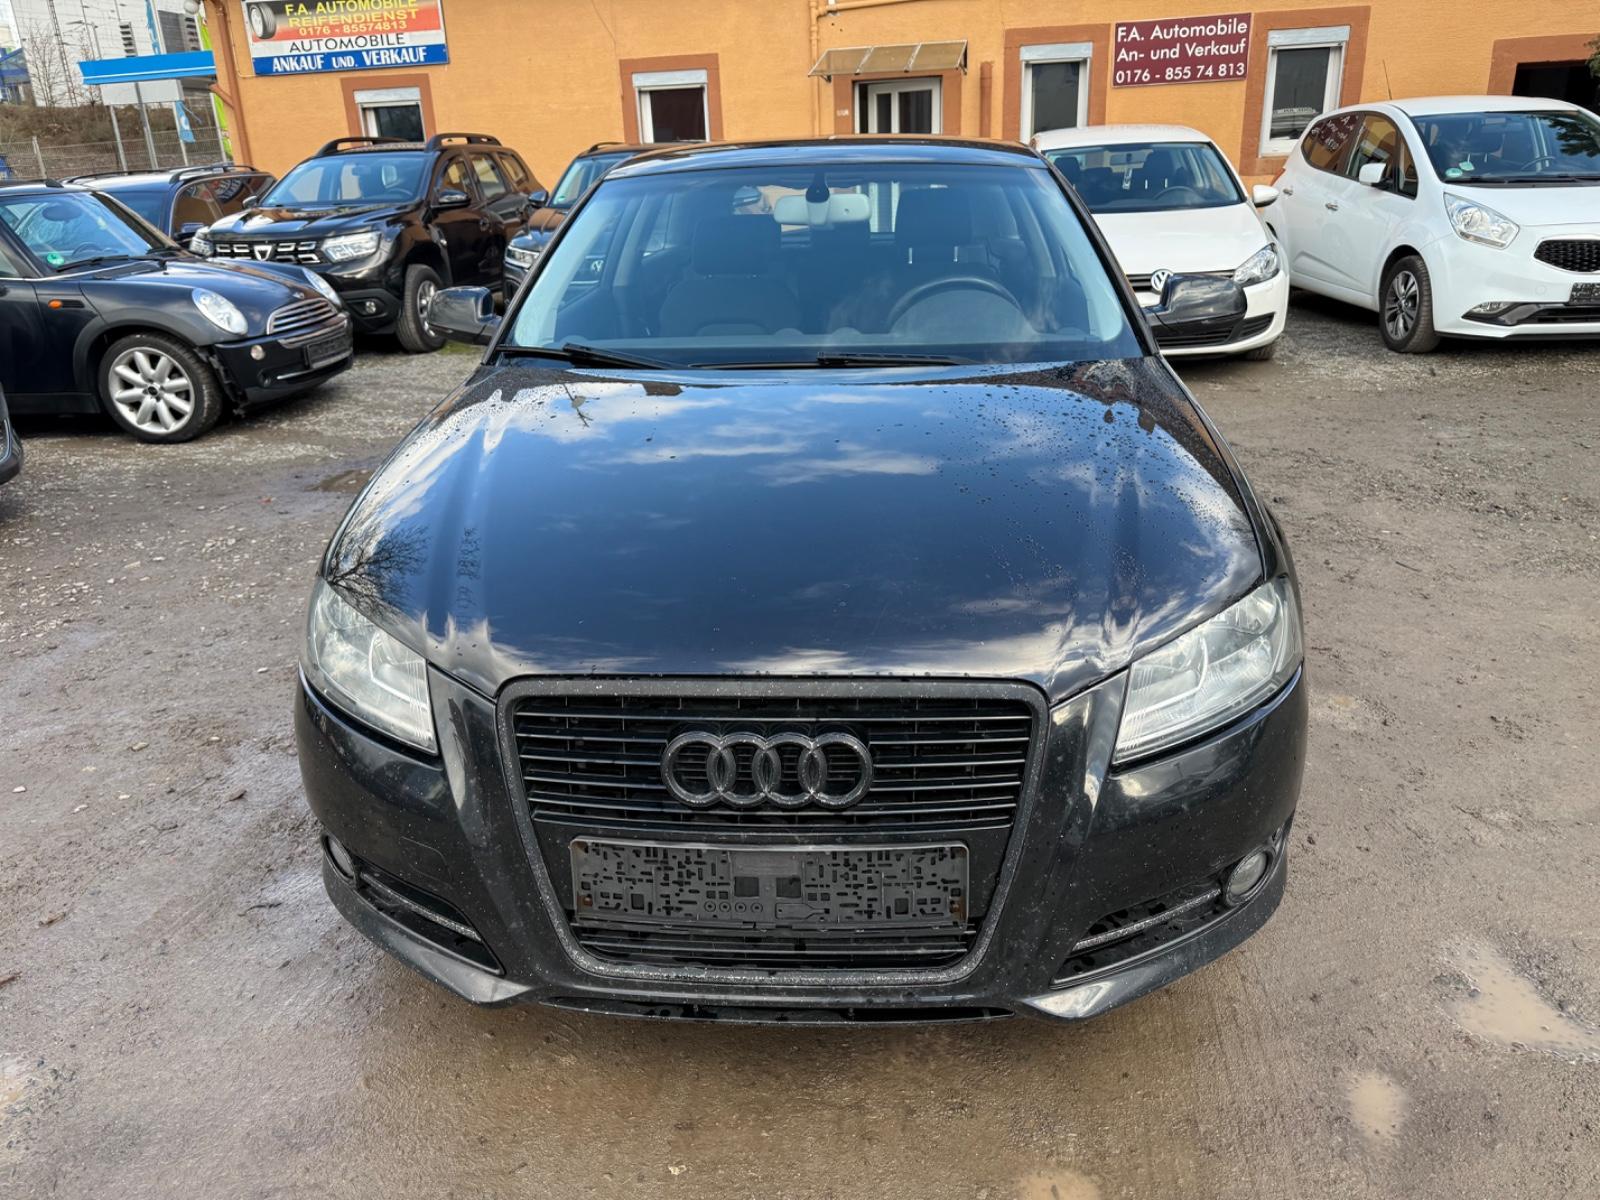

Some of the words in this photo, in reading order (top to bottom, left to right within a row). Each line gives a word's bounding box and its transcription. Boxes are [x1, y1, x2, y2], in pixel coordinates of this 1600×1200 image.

[285, 4, 312, 16] F.A.
[318, 0, 418, 14] AUTOMOBILE
[288, 9, 419, 28] REIFENDIENST
[299, 26, 329, 36] 0176
[343, 21, 407, 34] 85574813
[1117, 26, 1144, 42] F.A.
[1150, 18, 1248, 40] Automobile
[289, 33, 405, 53] AUTOMOBILE
[1117, 48, 1144, 62] An-
[1151, 43, 1180, 60] und
[1185, 38, 1247, 57] Verkauf
[272, 55, 324, 72] ANKAUF
[362, 47, 427, 65] VERKAUF
[1116, 70, 1150, 84] 0176
[1165, 66, 1191, 80] 855
[1196, 65, 1213, 78] 74
[1218, 63, 1245, 76] 813
